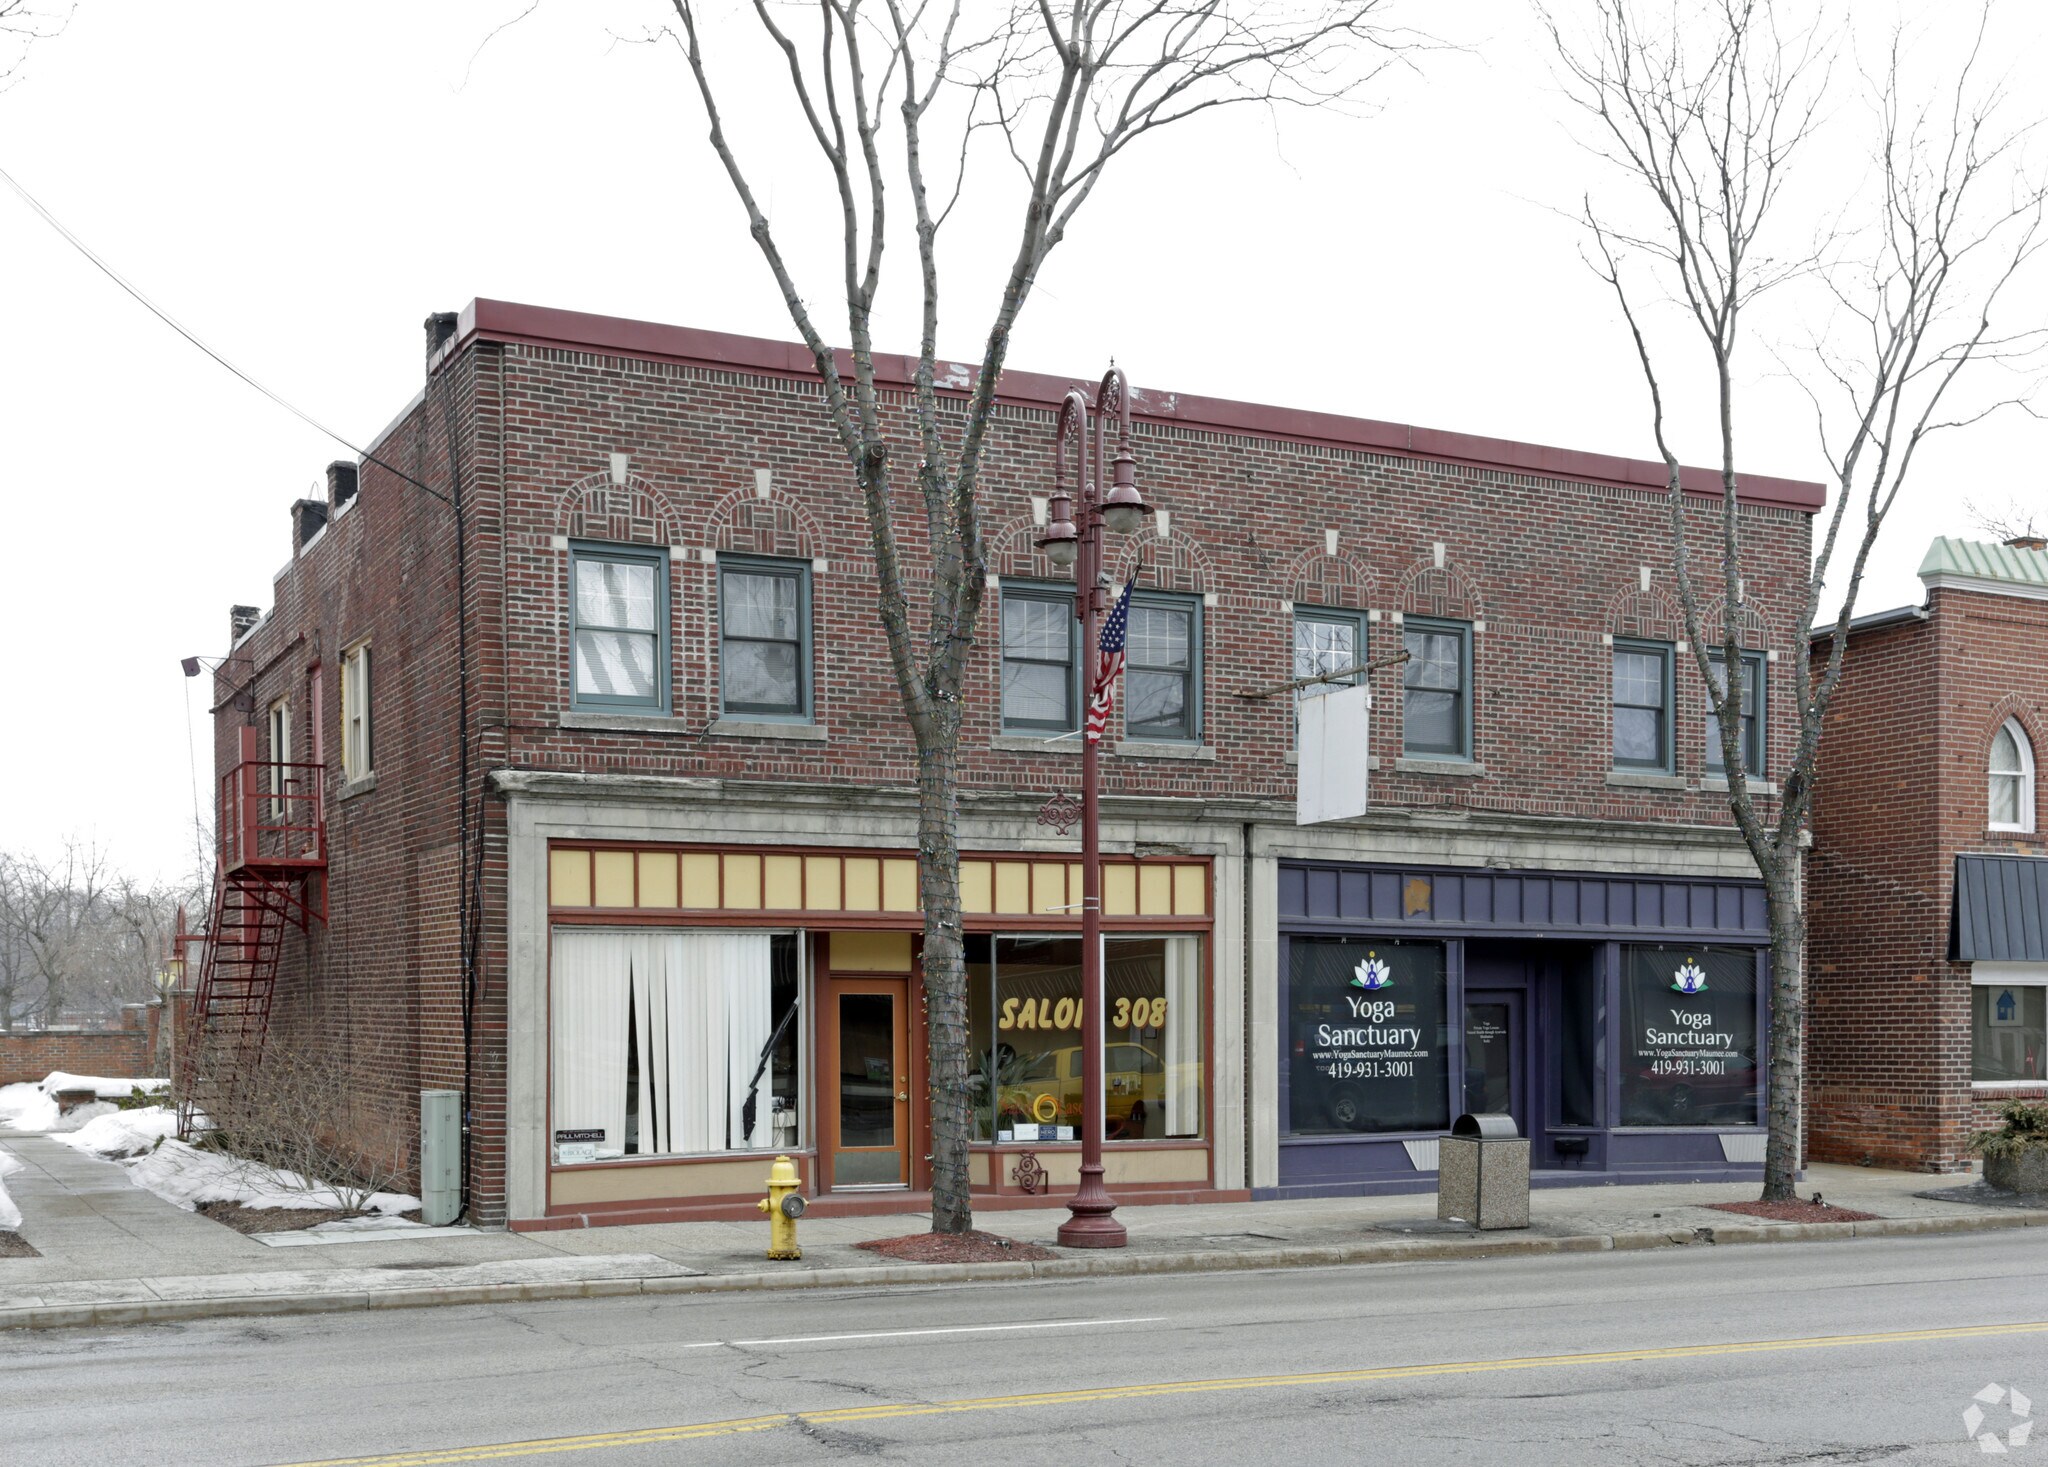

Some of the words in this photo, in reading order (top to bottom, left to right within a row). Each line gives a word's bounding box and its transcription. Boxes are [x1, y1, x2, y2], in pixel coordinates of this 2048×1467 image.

[1112, 997, 1168, 1029] 308
[1345, 996, 1395, 1023] Yoga
[1670, 1009, 1712, 1029] Yoga
[1318, 1024, 1421, 1050] Sanctuary
[1646, 1028, 1733, 1049] Sanctuary
[1312, 1049, 1429, 1060] www.YogaSanctuaryMaumee.com
[1638, 1048, 1738, 1059] www.YogaSanctuaryMaumee.com
[1328, 1061, 1414, 1078] 419-931-3001
[1651, 1060, 1725, 1075] 419-931-3001
